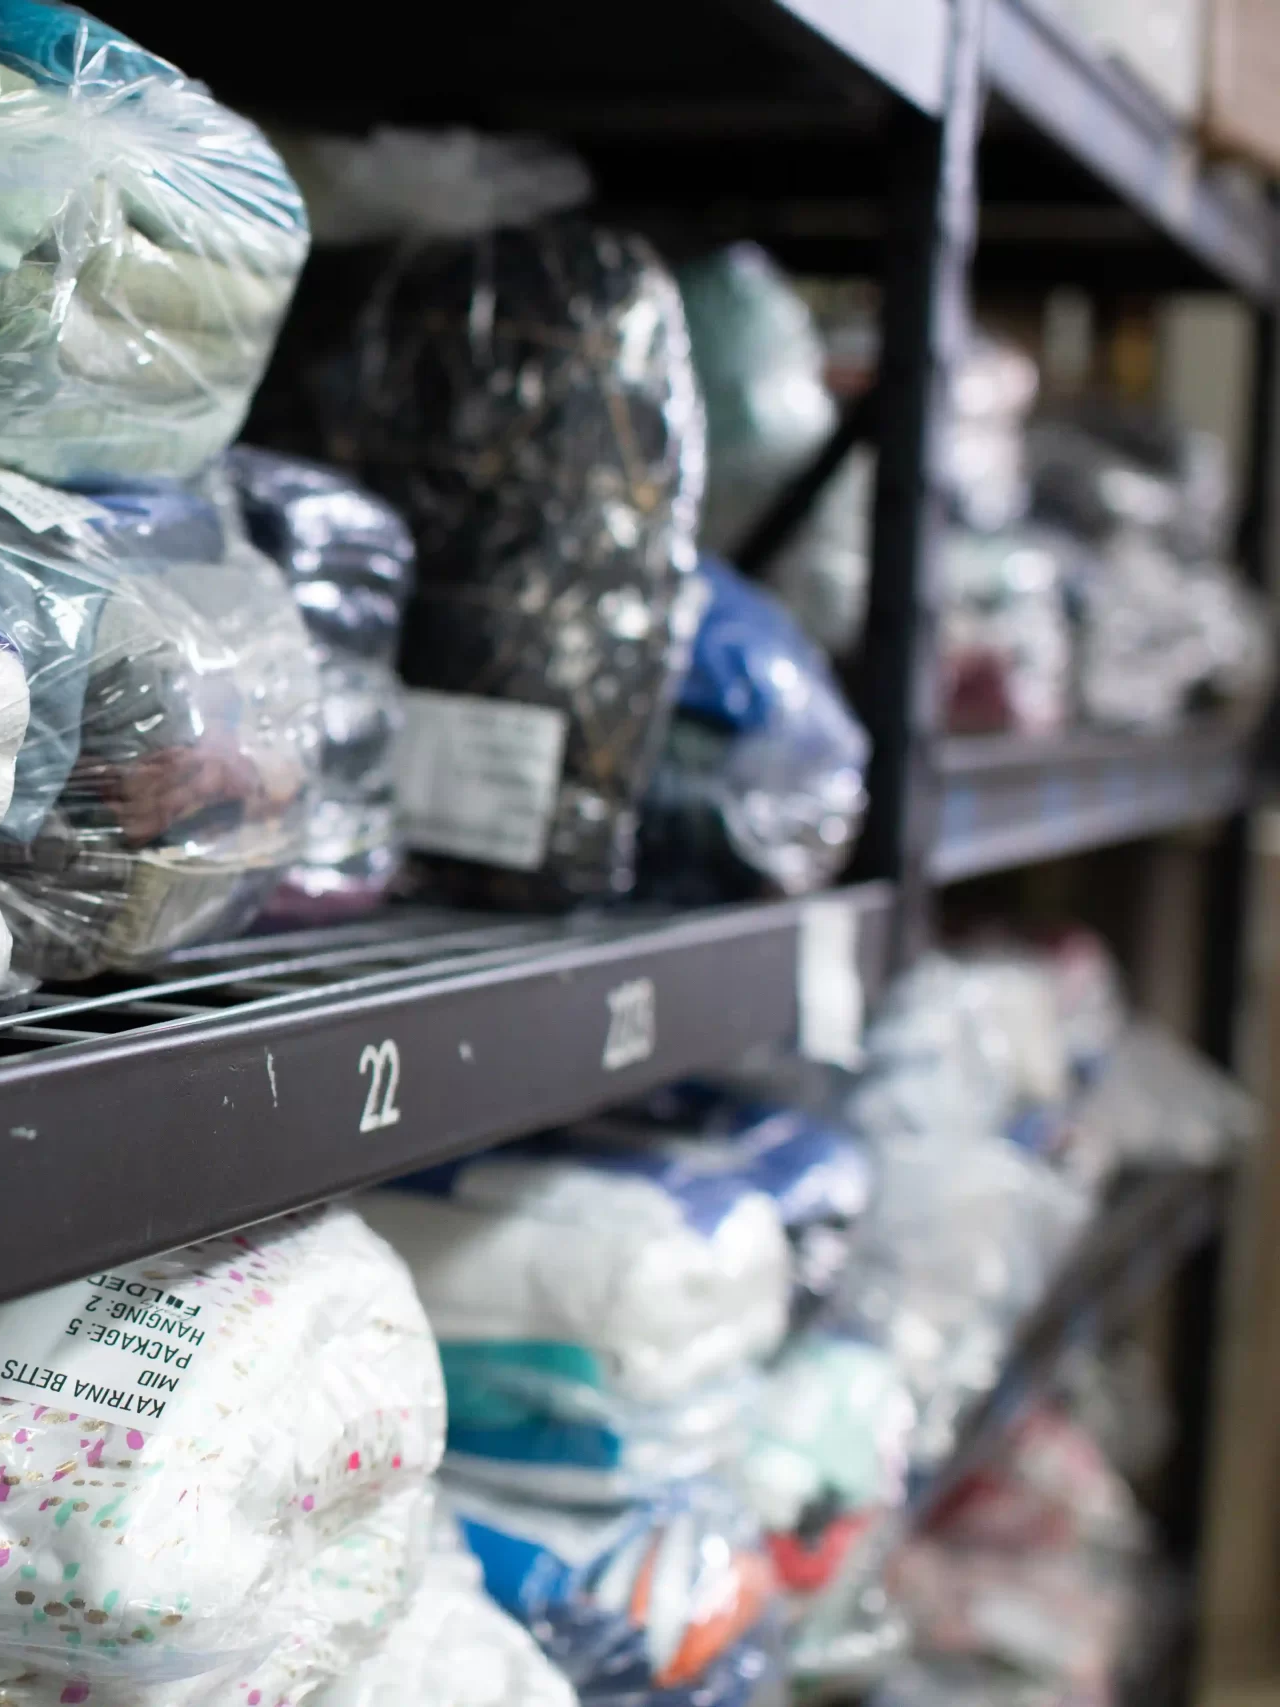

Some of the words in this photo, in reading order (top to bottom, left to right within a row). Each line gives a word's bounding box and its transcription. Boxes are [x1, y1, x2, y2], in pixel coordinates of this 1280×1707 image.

[359, 1039, 400, 1131] 22
[85, 1295, 102, 1312] 2
[65, 1318, 83, 1336] 5
[106, 1300, 205, 1346] HANGING:
[87, 1323, 192, 1369] PACKAGE:
[1, 1359, 68, 1392] BETTS
[137, 1370, 179, 1392] MID
[73, 1379, 166, 1418] KATRINA
